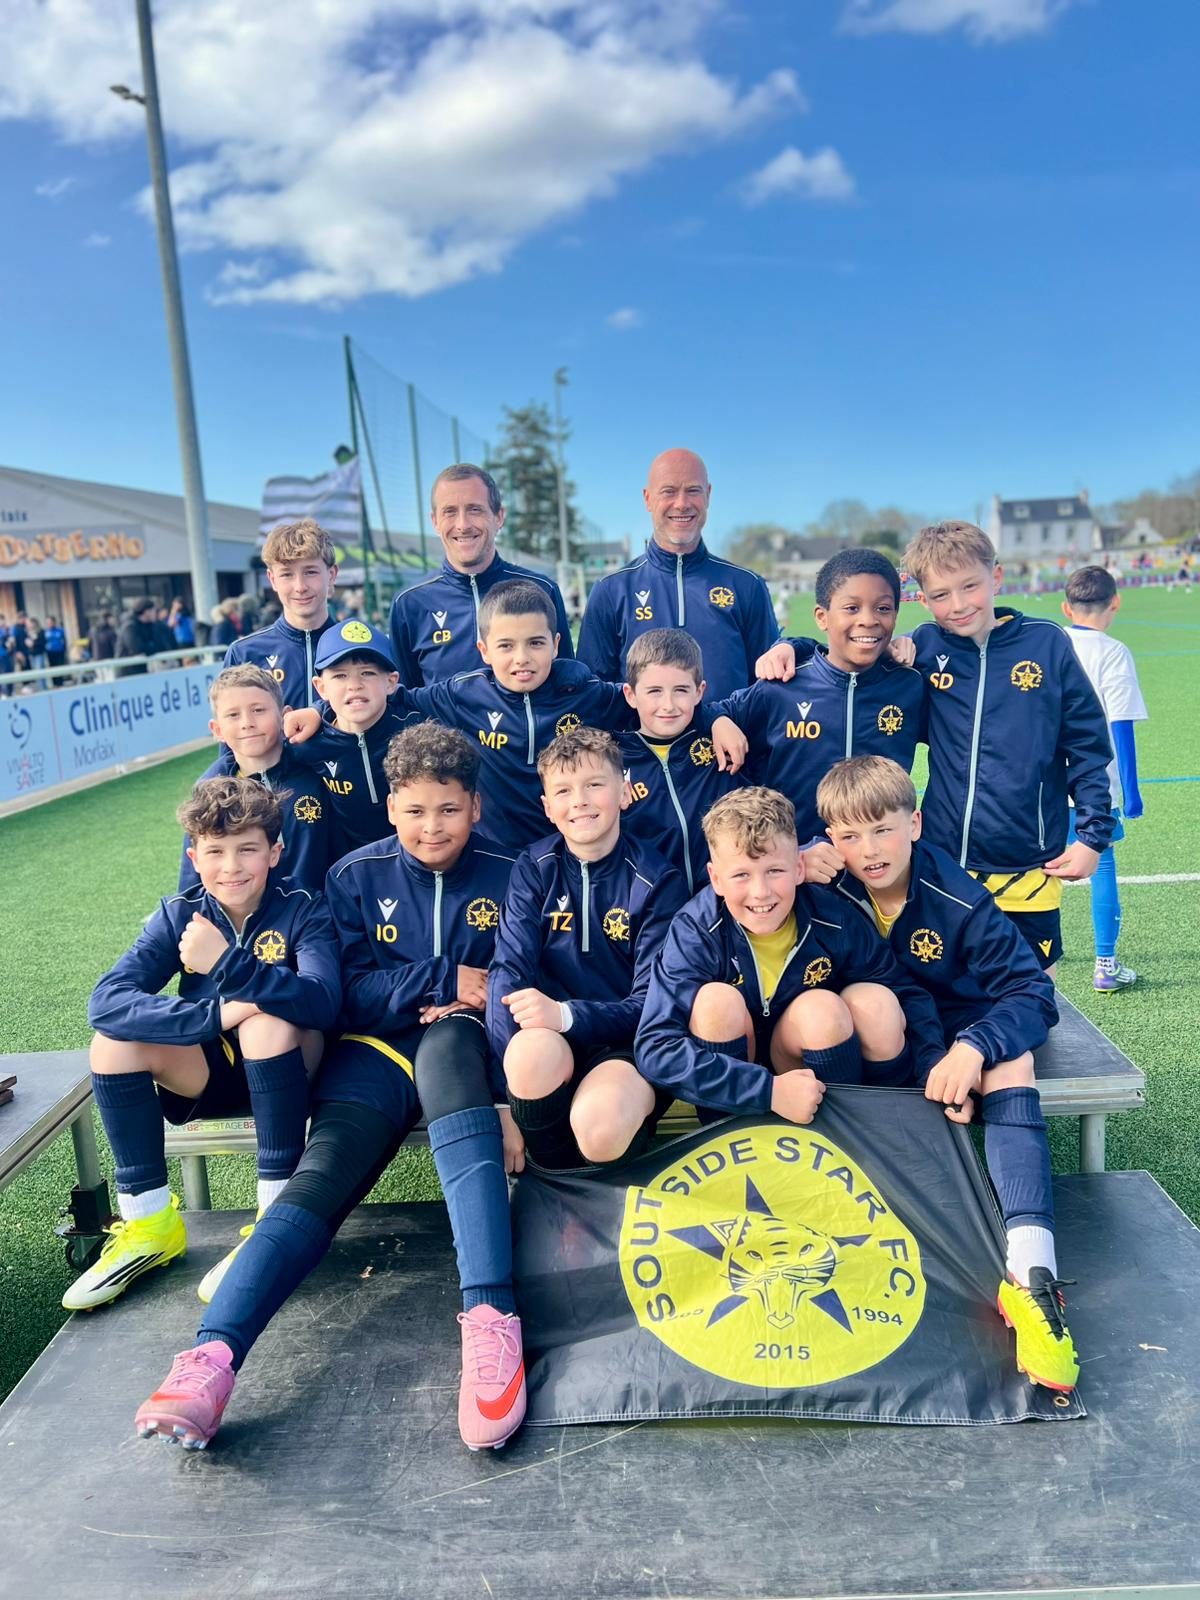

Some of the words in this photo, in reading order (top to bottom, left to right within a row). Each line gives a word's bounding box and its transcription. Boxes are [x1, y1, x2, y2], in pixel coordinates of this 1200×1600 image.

[635, 607, 653, 620] SS
[433, 630, 451, 644] CB
[264, 669, 285, 682] D
[930, 672, 954, 689] SD
[69, 692, 154, 736] Clinique
[160, 680, 181, 714] de
[186, 677, 201, 707] la
[786, 721, 821, 739] MO
[479, 731, 508, 750] MP
[73, 738, 116, 769] Morlaix
[322, 776, 353, 795] MLP
[549, 911, 573, 931] TZ
[774, 1136, 887, 1223] STAR
[852, 1306, 904, 1326] 1994
[754, 1343, 810, 1360] 2015
